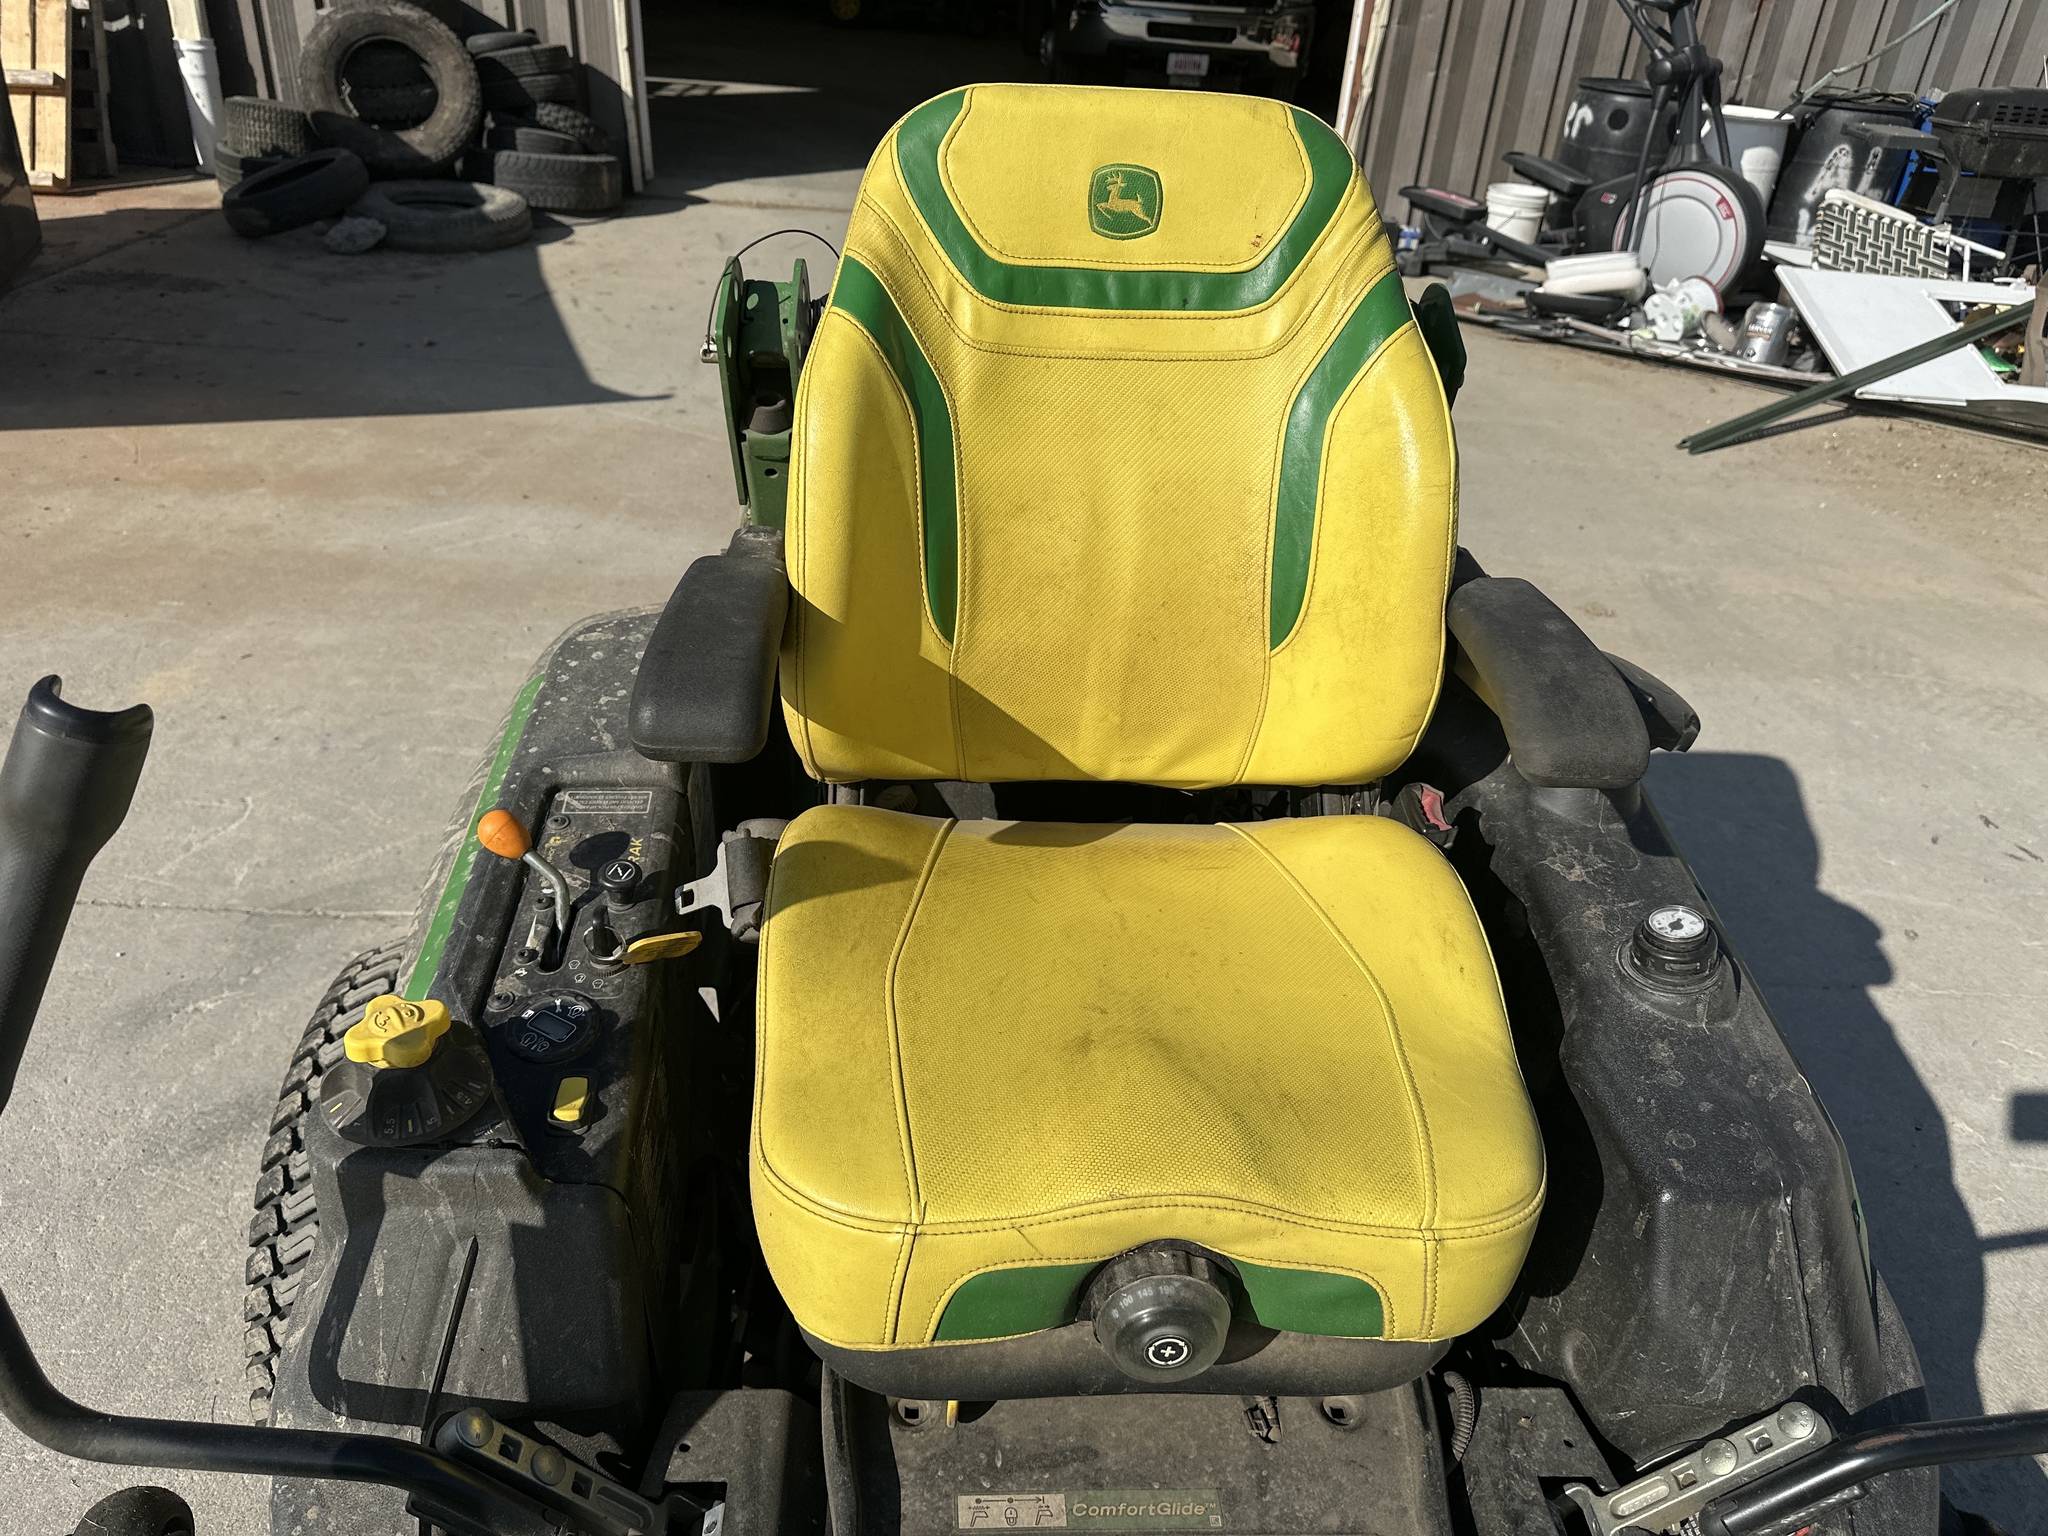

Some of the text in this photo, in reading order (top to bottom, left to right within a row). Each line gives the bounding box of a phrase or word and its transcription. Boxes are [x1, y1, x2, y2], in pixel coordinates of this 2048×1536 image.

[1119, 1294, 1134, 1309] 100
[1137, 1286, 1154, 1299] 145
[1158, 1284, 1176, 1296] 190
